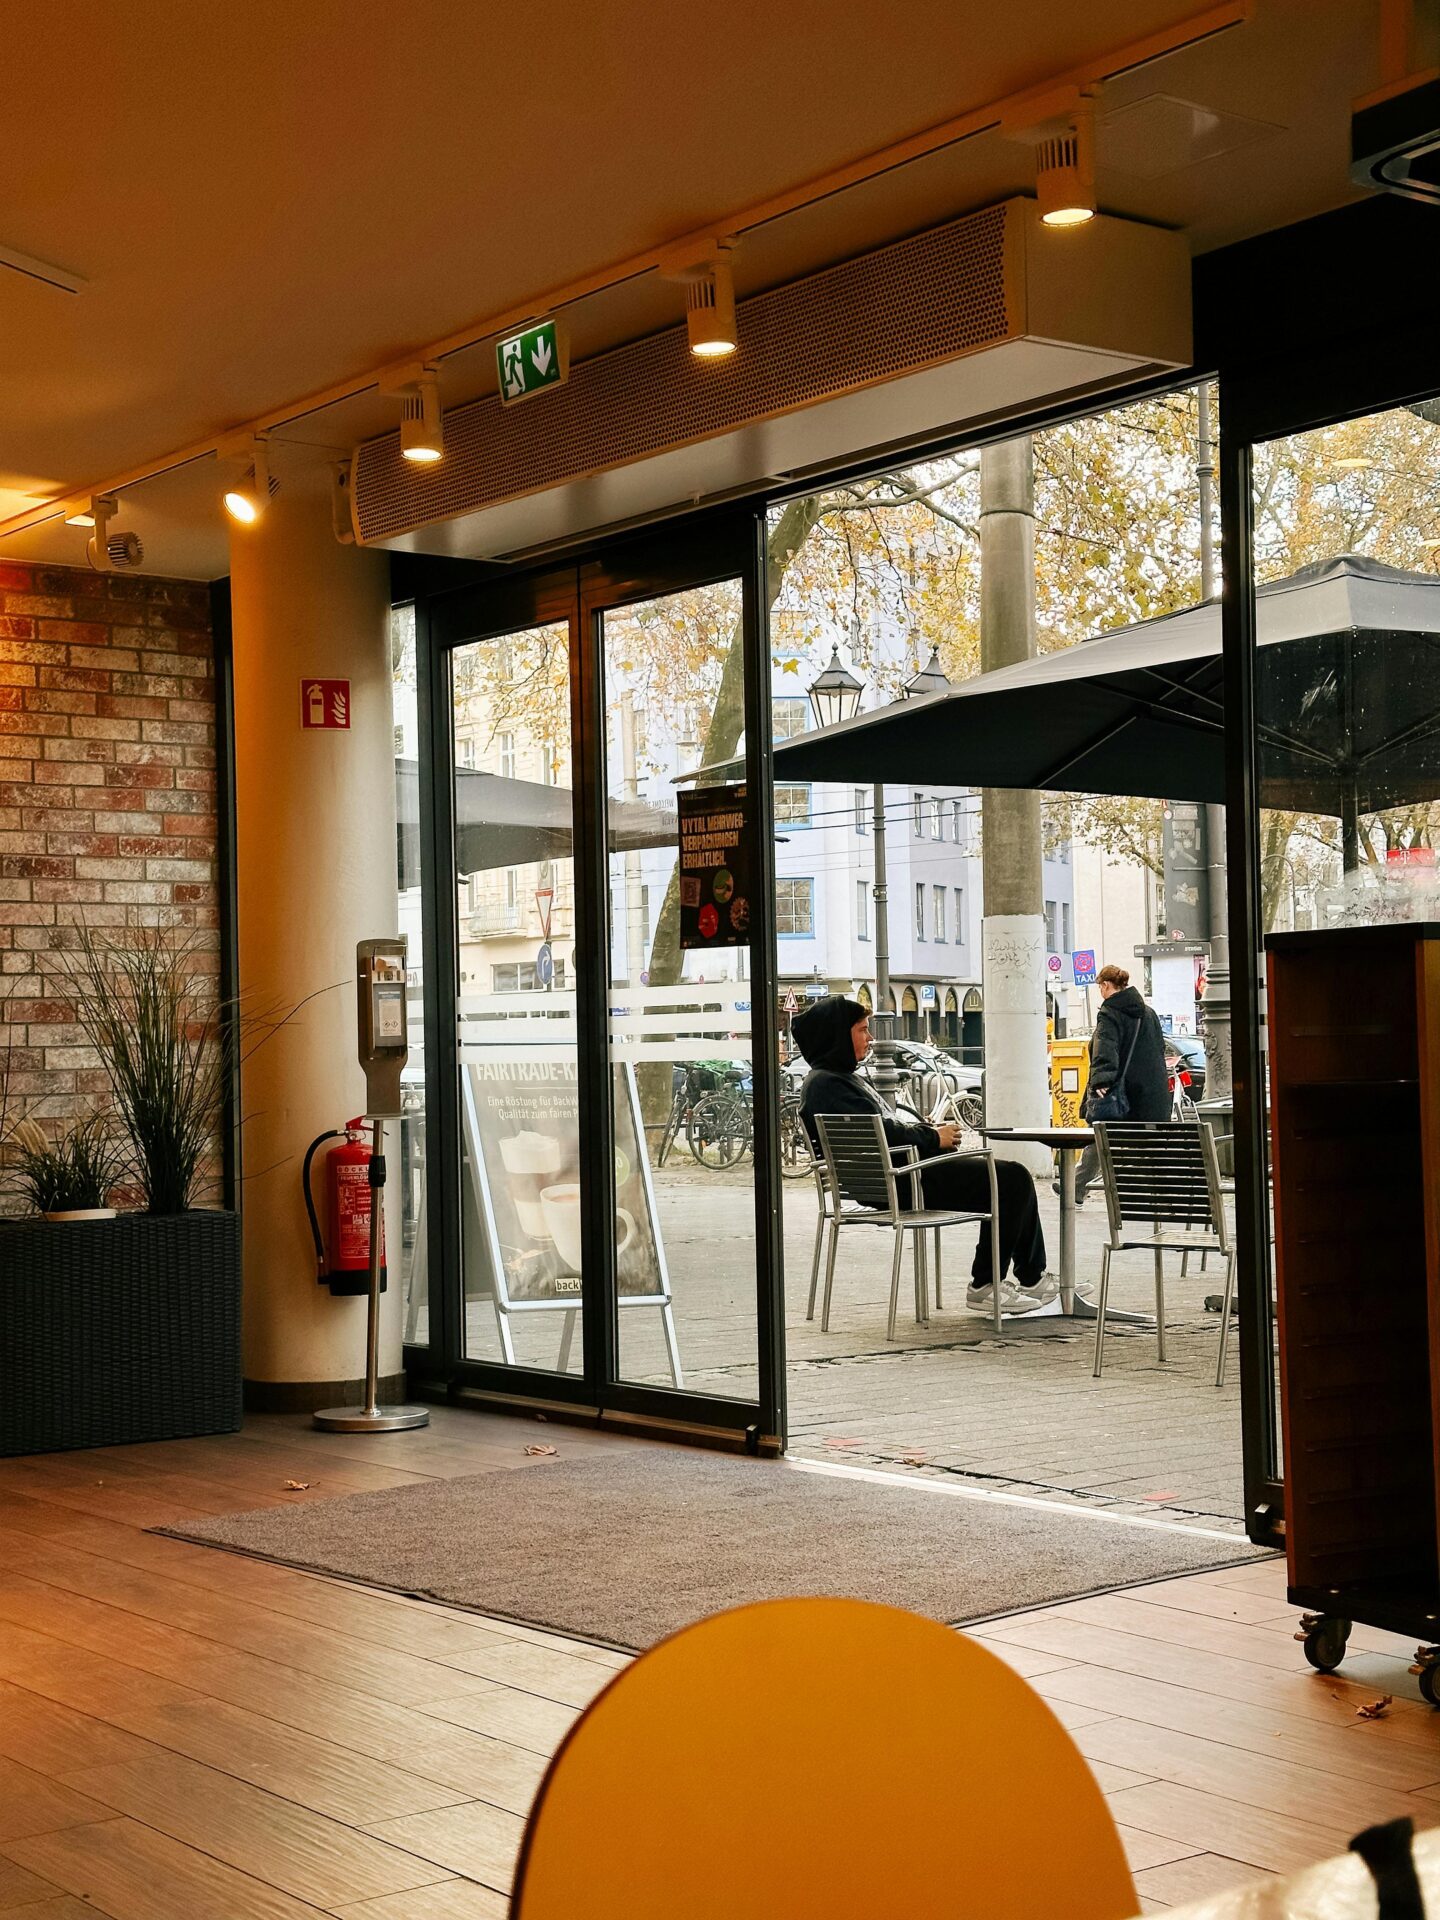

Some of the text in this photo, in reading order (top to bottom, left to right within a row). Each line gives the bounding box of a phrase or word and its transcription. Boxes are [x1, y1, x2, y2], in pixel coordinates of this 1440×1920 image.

[1076, 973, 1095, 983] TAXI
[922, 987, 931, 998] P
[475, 1063, 578, 1081] FAIRTRADE-K
[487, 1096, 505, 1107] Eine
[505, 1096, 538, 1109] Röstung
[539, 1096, 551, 1106] für
[498, 1108, 530, 1120] Qualität
[531, 1111, 548, 1119] zum
[549, 1107, 572, 1119] fairen
[556, 1279, 580, 1291] back
